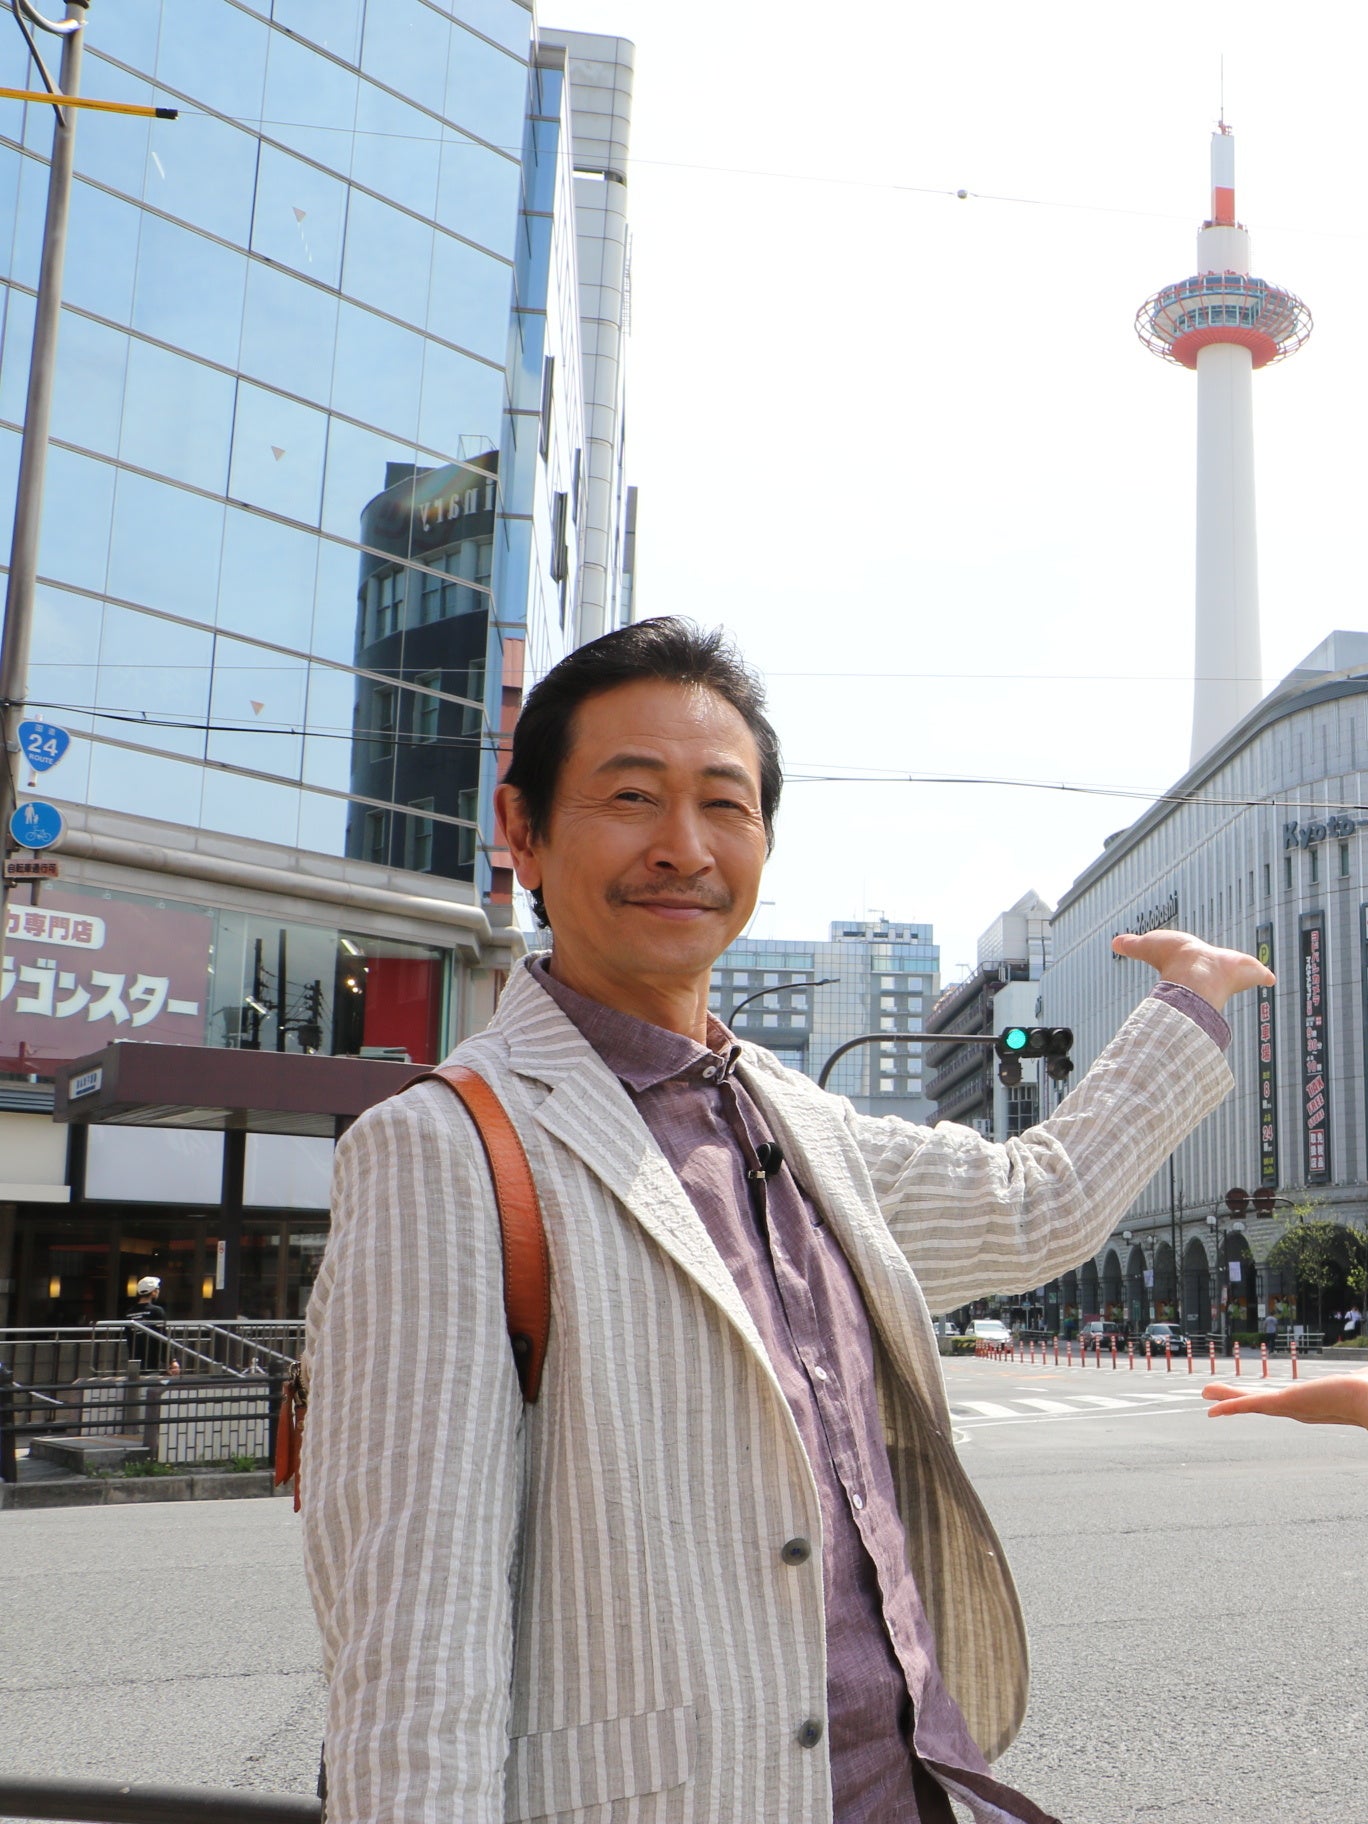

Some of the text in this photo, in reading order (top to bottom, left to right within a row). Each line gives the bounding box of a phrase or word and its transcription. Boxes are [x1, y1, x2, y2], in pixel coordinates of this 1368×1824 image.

[28, 733, 58, 757] 24
[28, 753, 54, 765] ROUTE
[8, 863, 57, 874] 自転車通行可
